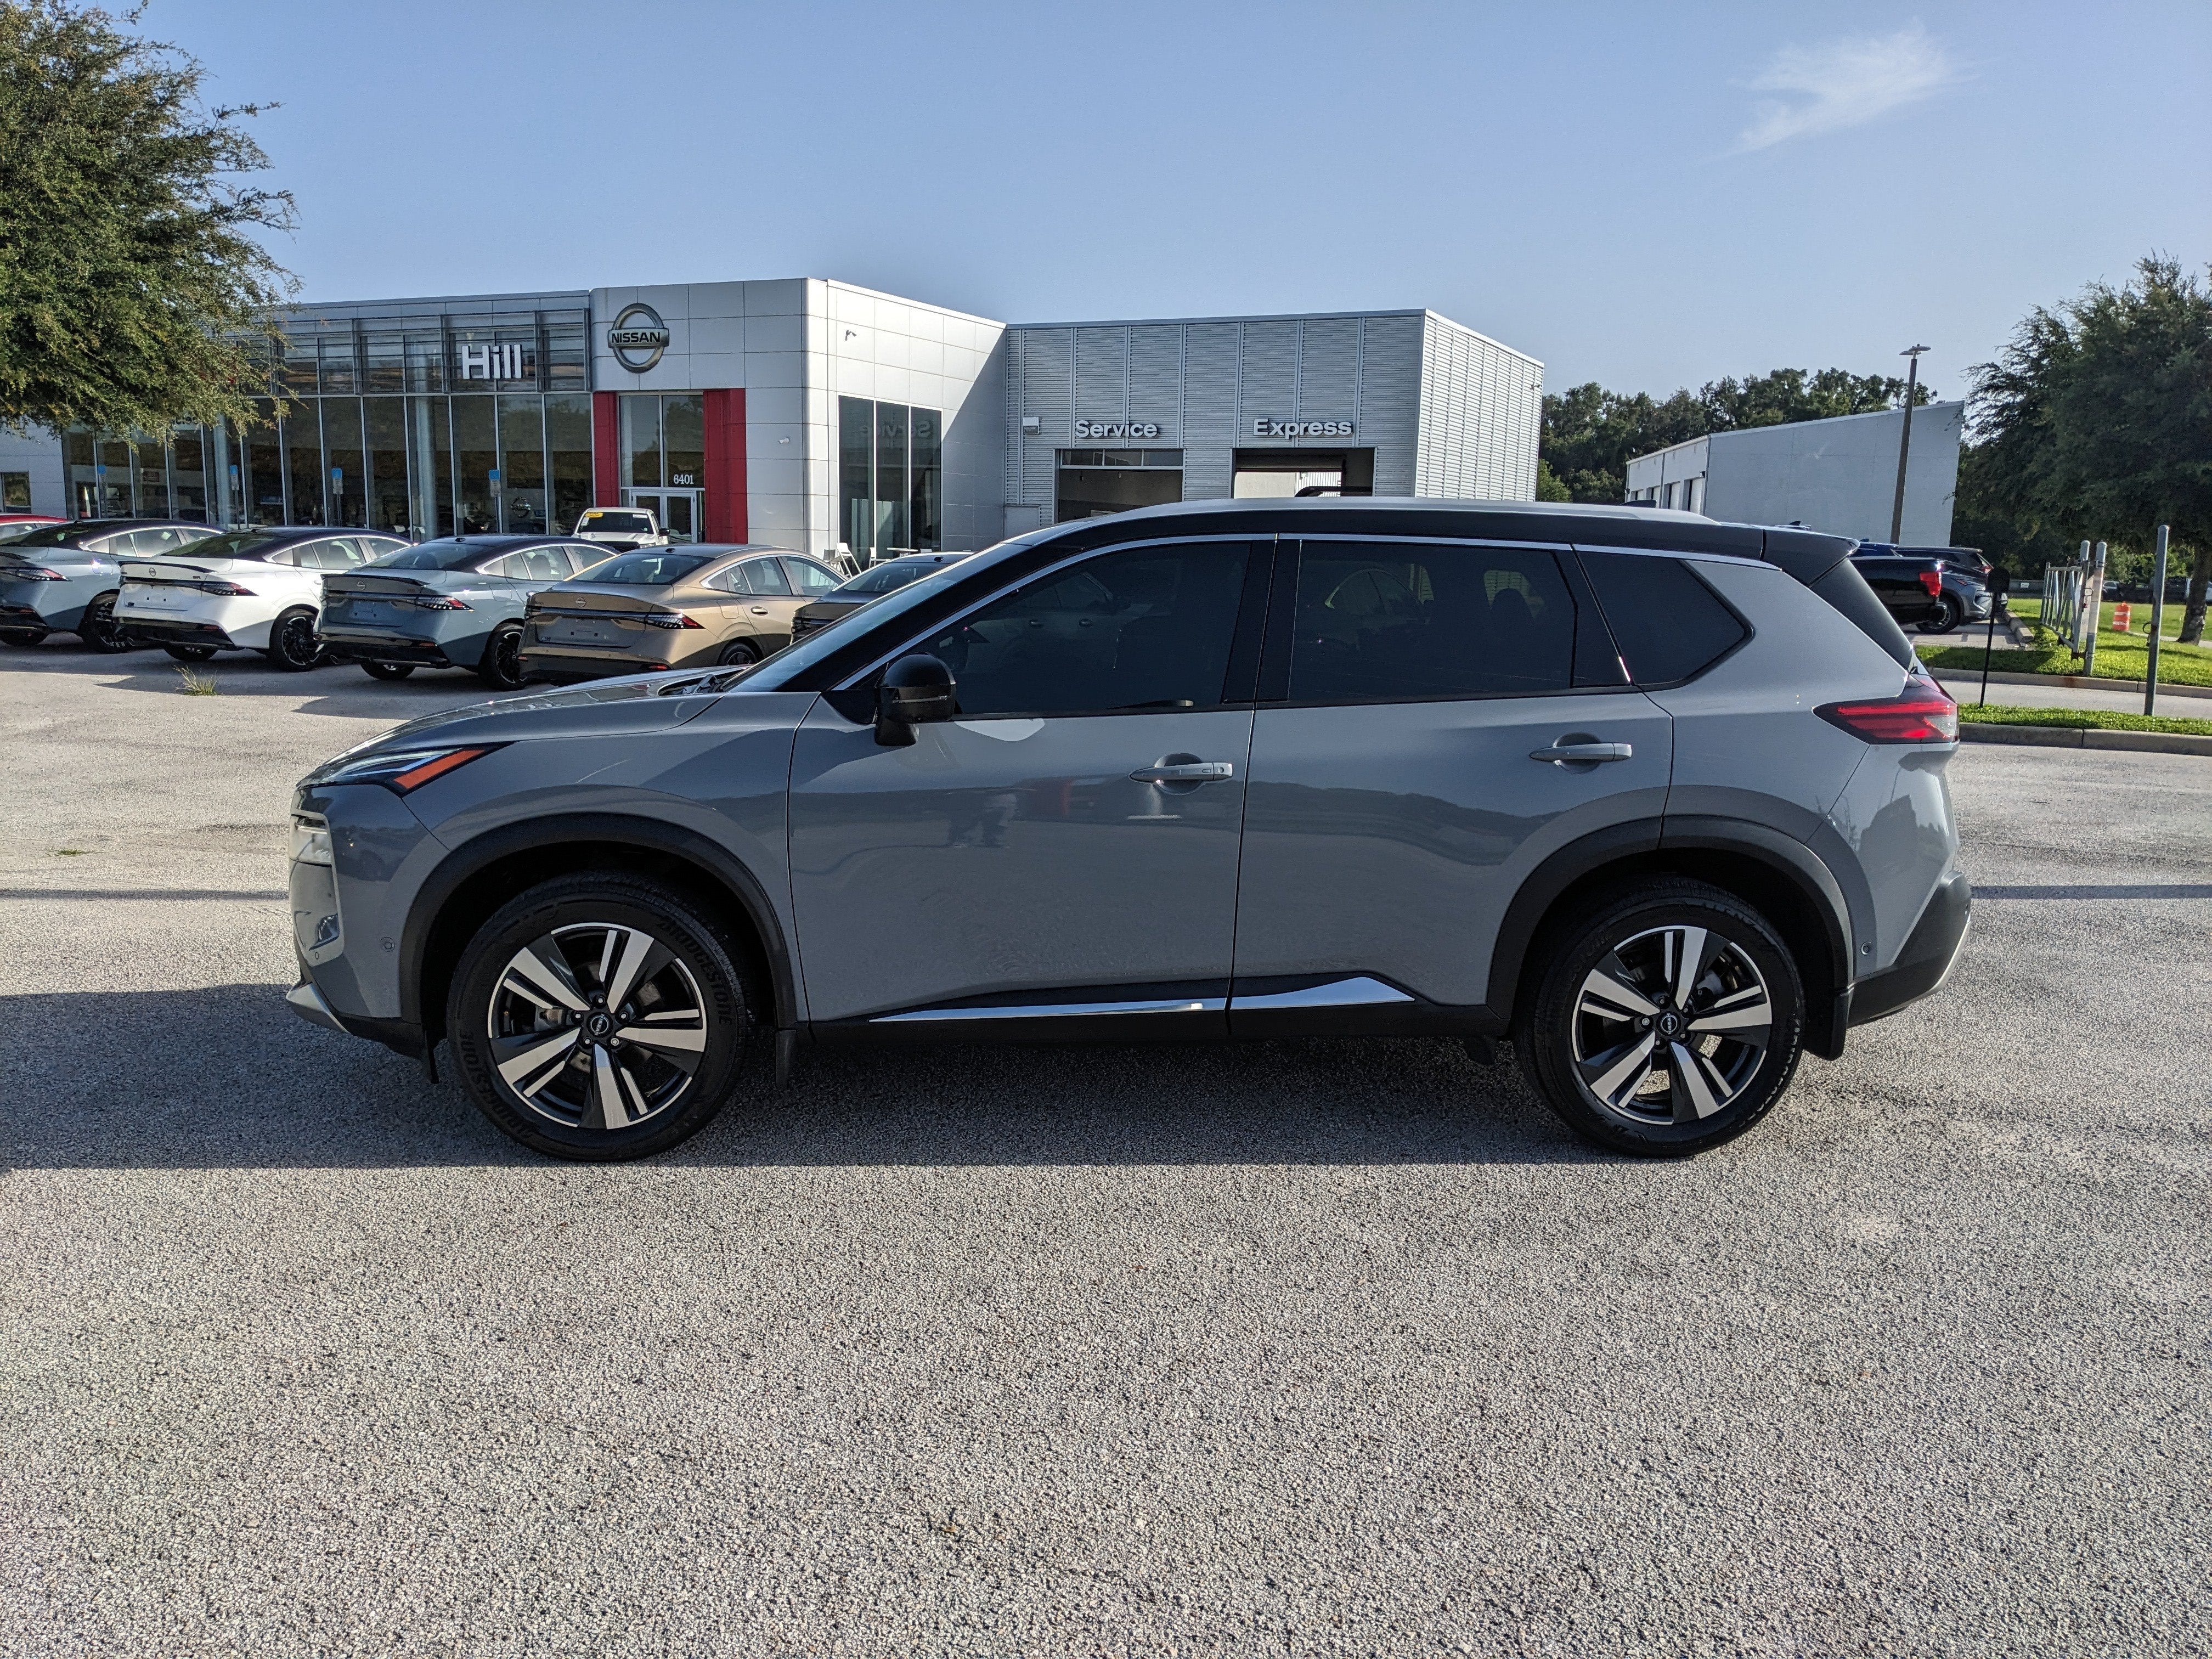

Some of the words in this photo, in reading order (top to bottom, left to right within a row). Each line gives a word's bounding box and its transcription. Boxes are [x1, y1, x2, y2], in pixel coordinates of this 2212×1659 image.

[612, 331, 661, 344] NISSAN
[462, 344, 523, 380] Hill
[1075, 420, 1158, 437] Service
[1253, 418, 1352, 440] Express
[673, 474, 695, 484] 6401
[594, 1013, 606, 1036] NISSAN
